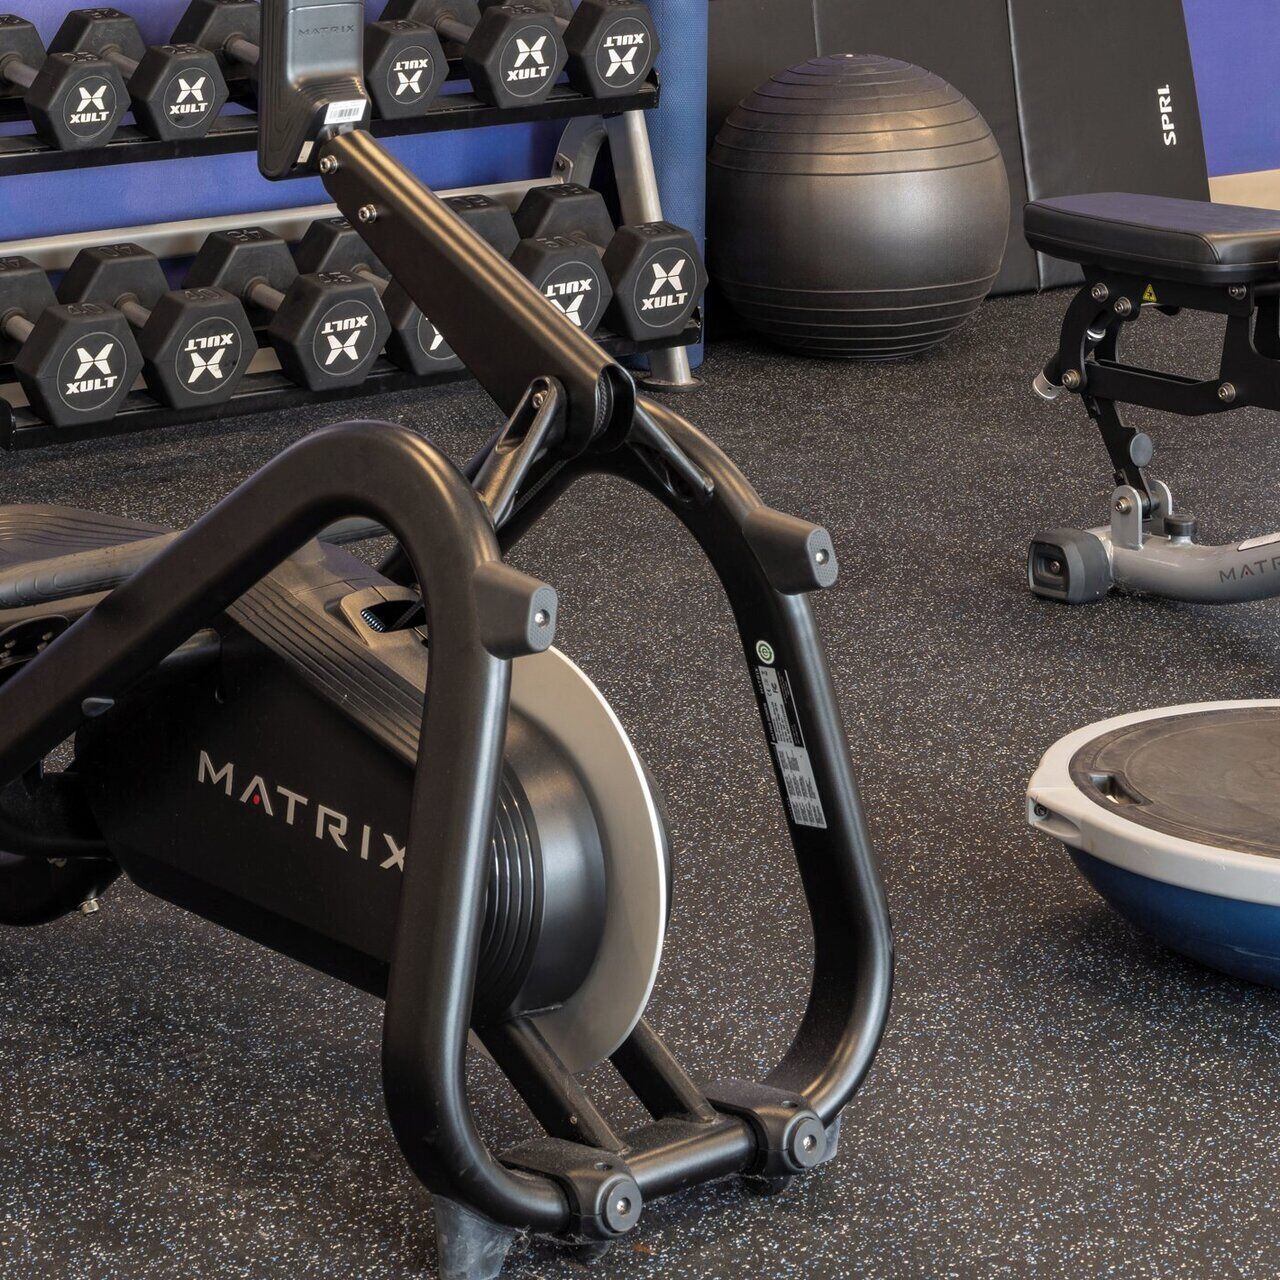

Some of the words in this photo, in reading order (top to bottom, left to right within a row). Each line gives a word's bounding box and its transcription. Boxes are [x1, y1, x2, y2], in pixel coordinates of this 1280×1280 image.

[297, 24, 355, 37] MATRIX
[604, 33, 644, 47] XULT
[393, 59, 428, 71] XULT
[507, 66, 549, 81] XULT
[170, 102, 208, 114] XULT
[70, 111, 109, 123] XULT
[544, 279, 592, 298] XULT
[642, 292, 688, 310] XULT
[321, 315, 368, 334] XULT
[185, 333, 233, 351] XULT
[66, 375, 117, 394] XULT
[199, 747, 407, 871] MATRIX
